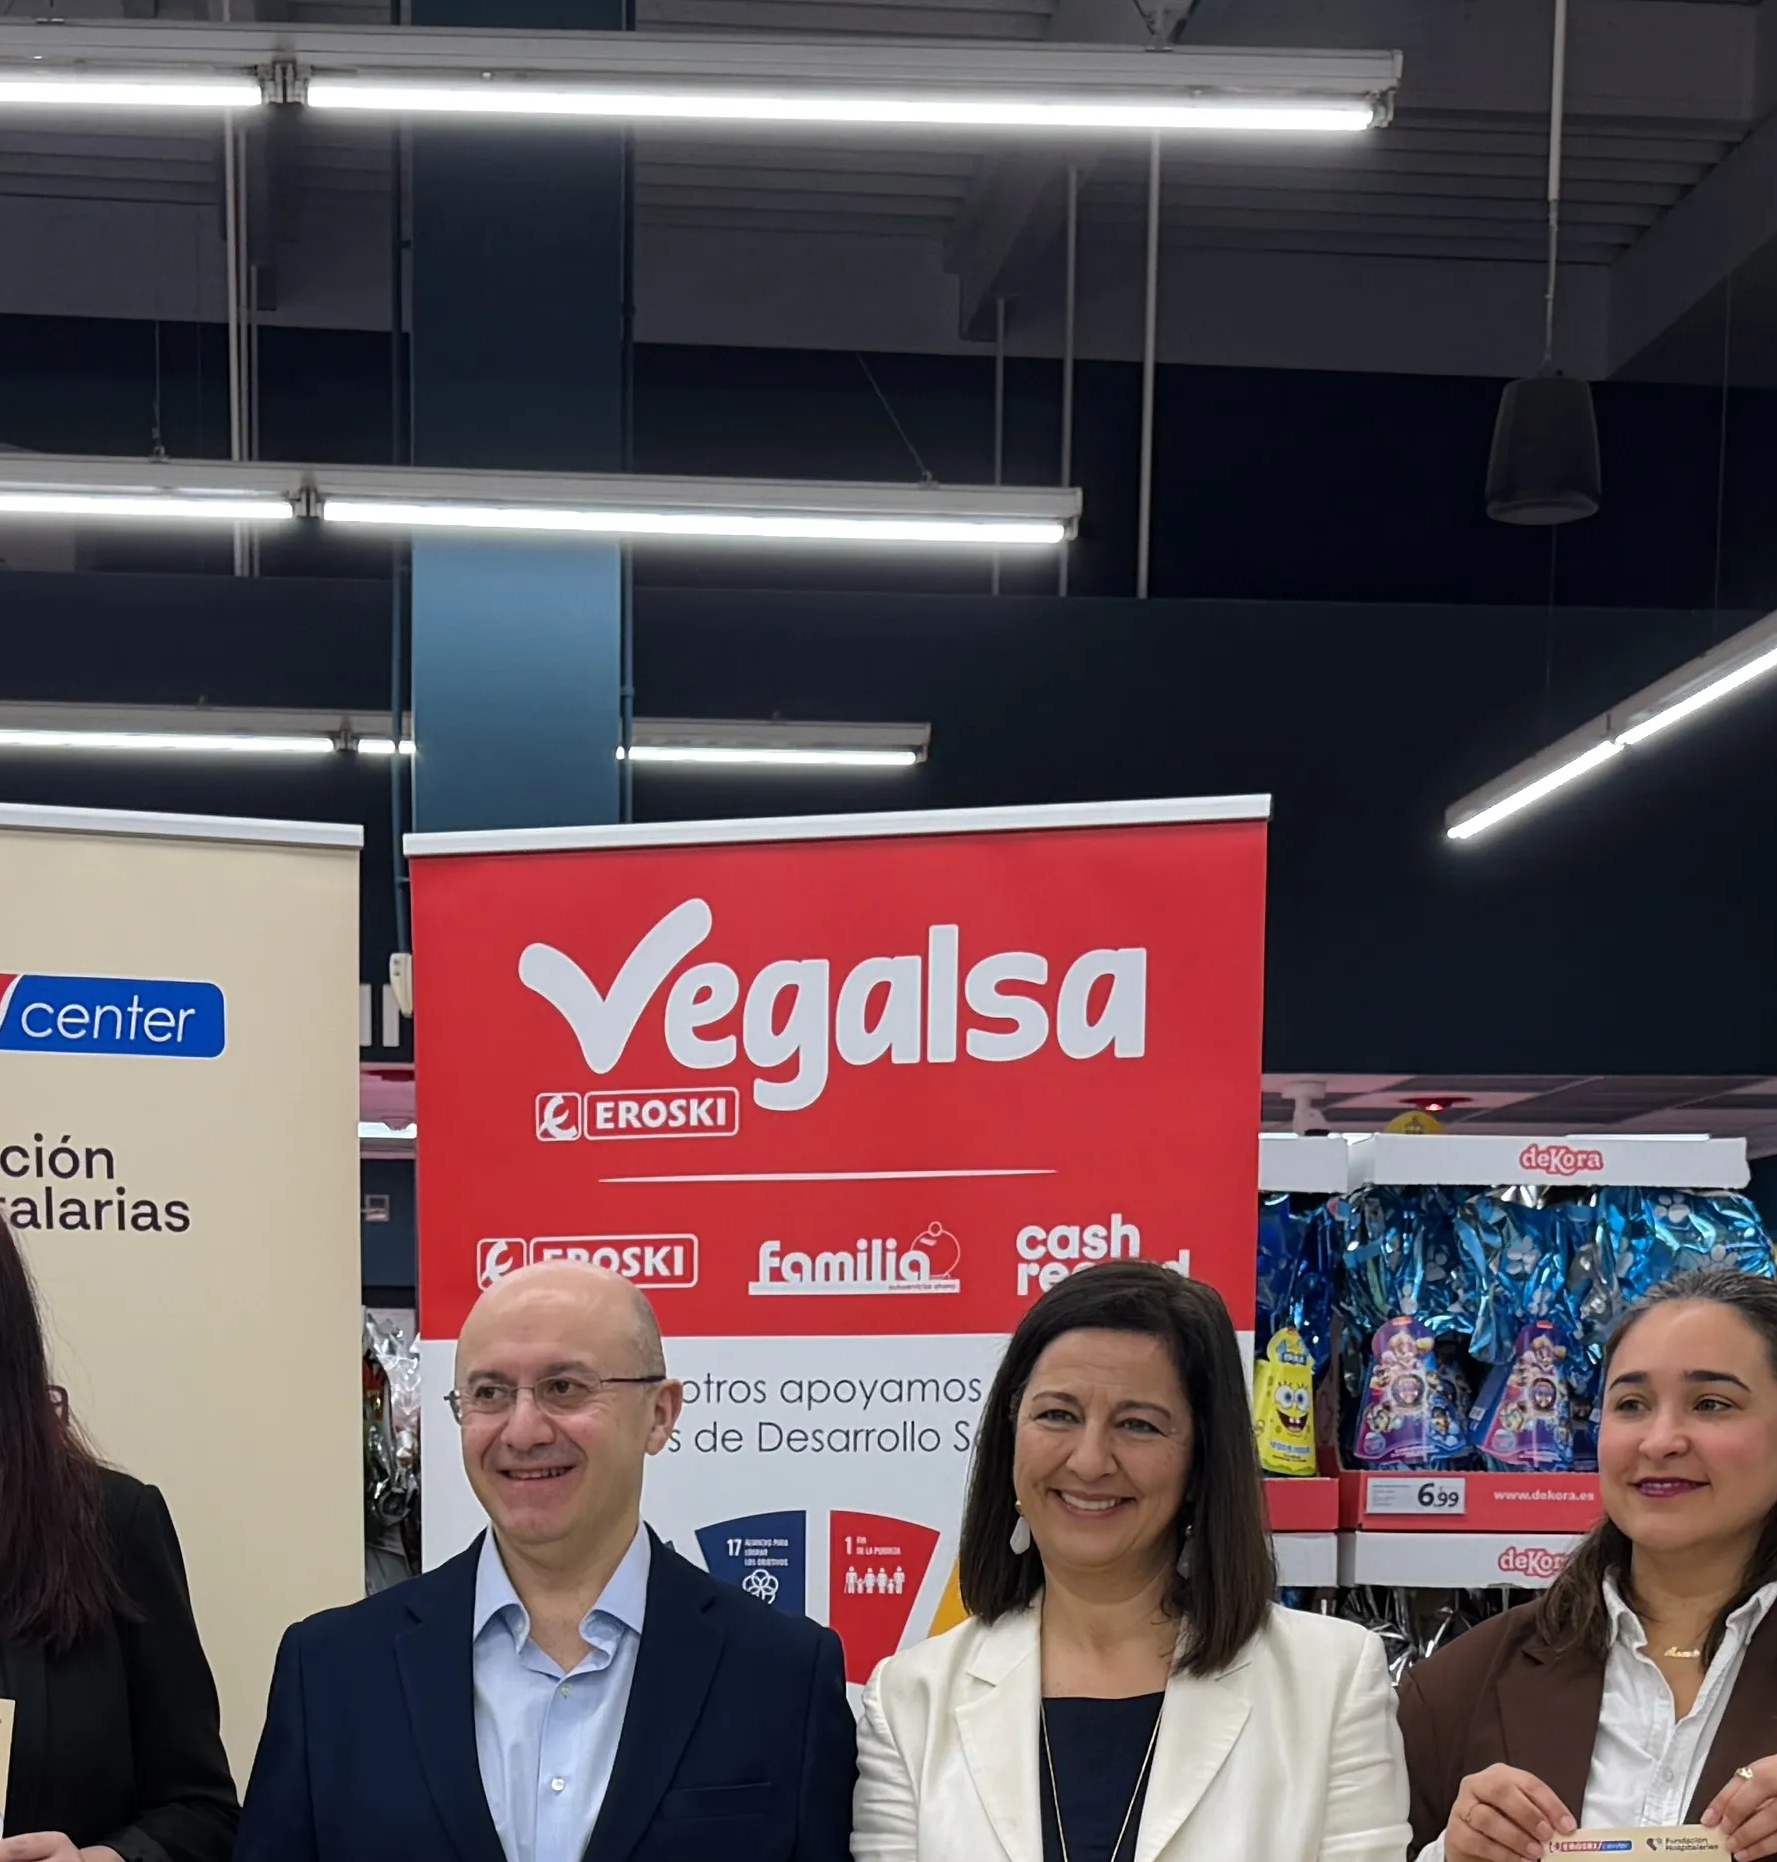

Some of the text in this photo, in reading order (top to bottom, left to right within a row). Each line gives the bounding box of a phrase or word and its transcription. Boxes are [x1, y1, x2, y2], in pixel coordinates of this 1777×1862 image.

[518, 897, 1148, 1111] Vegalsa
[20, 996, 197, 1045] center
[595, 1097, 727, 1130] EROSKI
[1016, 1213, 1141, 1261] cash
[682, 1373, 982, 1411] otros apoyamos
[695, 1421, 743, 1453] de
[758, 1421, 941, 1453] Desarrollo
[1493, 1489, 1594, 1501] www.dekora.es
[727, 1538, 742, 1557] 17
[844, 1536, 853, 1556] 1
[1498, 1546, 1570, 1578] deKor
